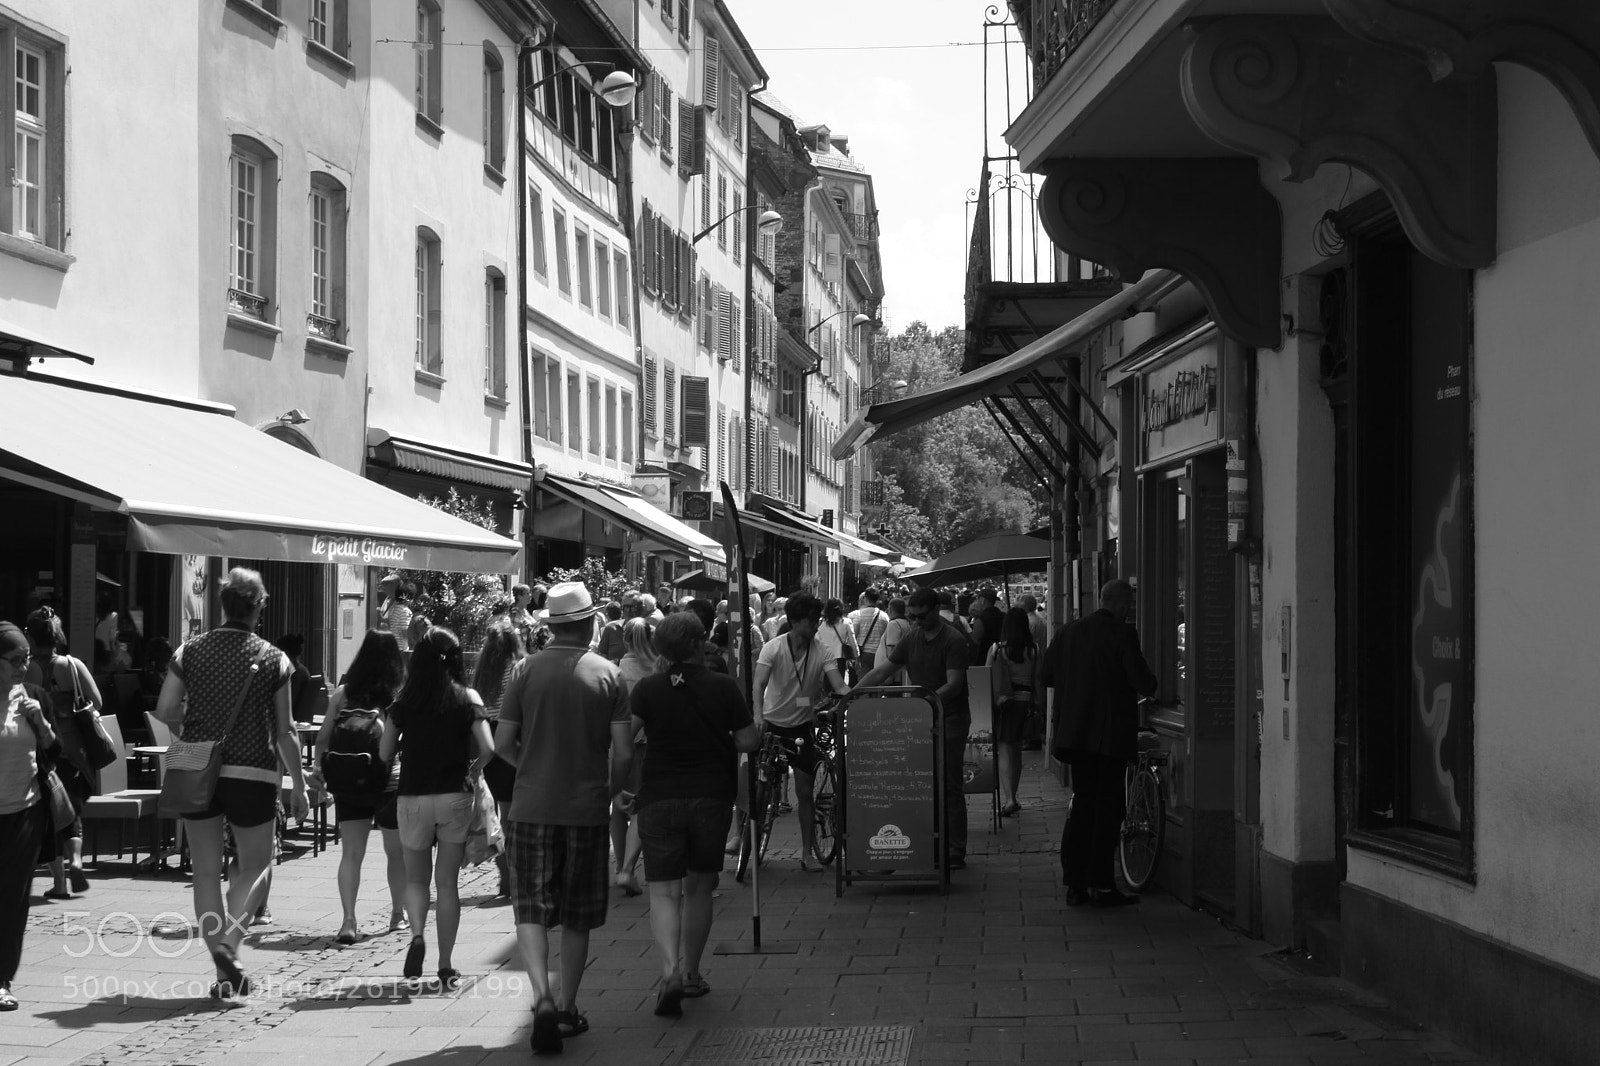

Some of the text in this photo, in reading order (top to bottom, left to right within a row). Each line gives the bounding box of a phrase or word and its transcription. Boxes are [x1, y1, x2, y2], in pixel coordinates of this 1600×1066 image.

[312, 534, 408, 562] le petit Glacier
[1432, 635, 1454, 659] Choix
